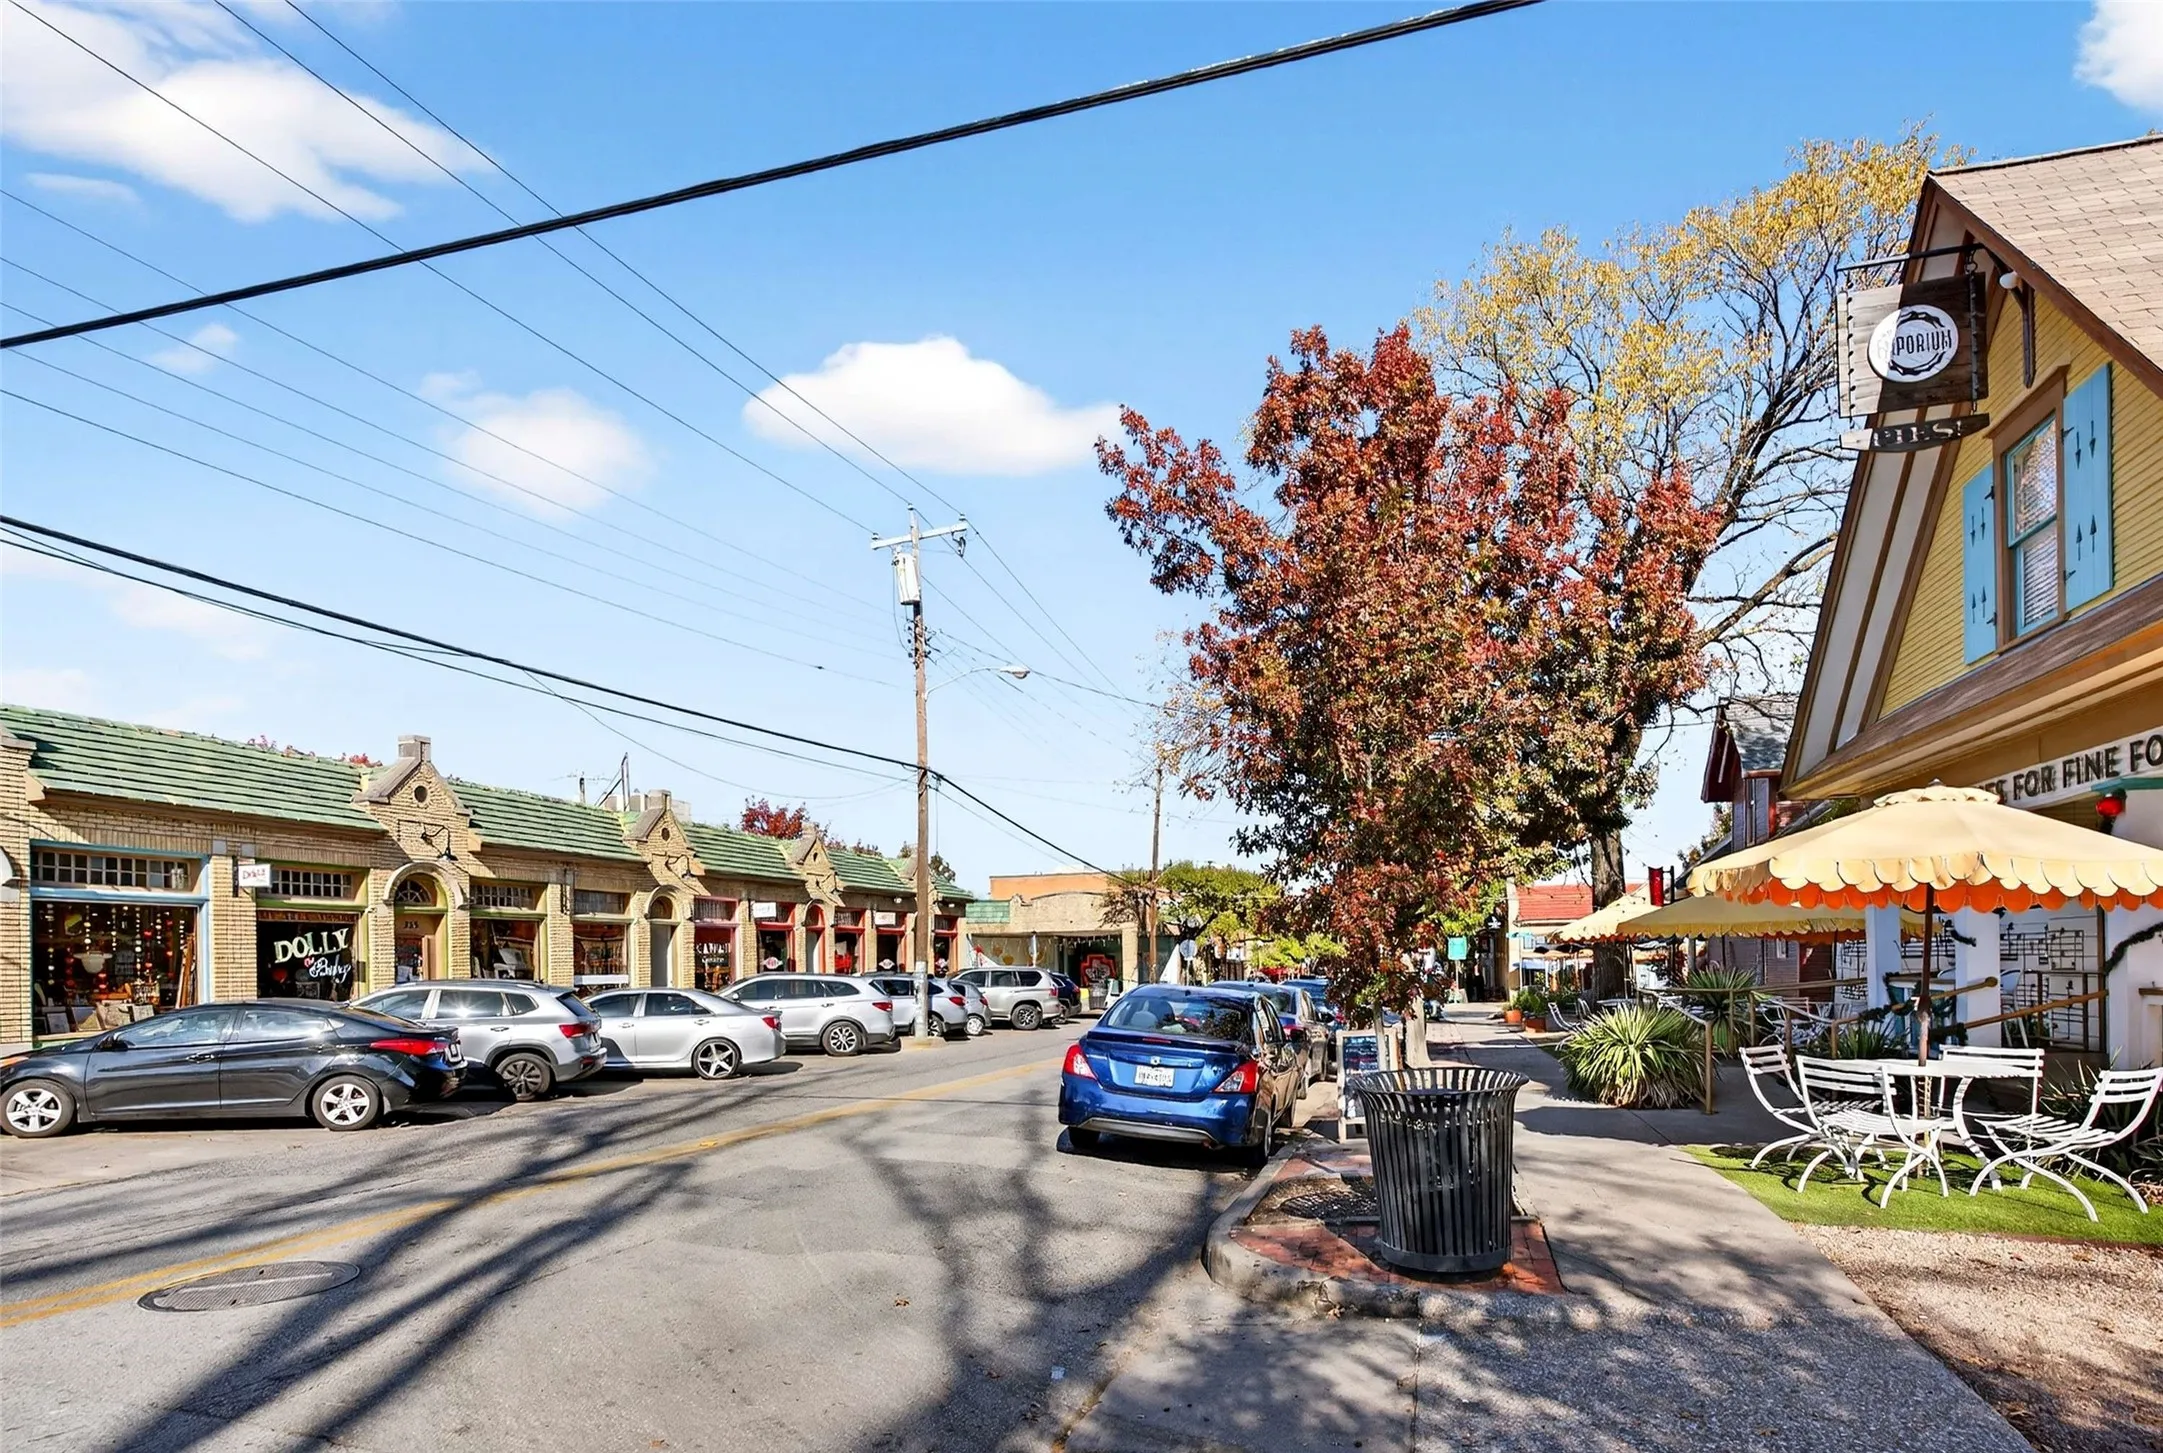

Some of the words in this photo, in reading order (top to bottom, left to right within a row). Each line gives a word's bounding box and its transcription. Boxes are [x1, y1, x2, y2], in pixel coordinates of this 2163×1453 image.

[2013, 766, 2056, 801] FOR
[2063, 746, 2121, 788] FINE
[273, 927, 349, 964] DOLLY
